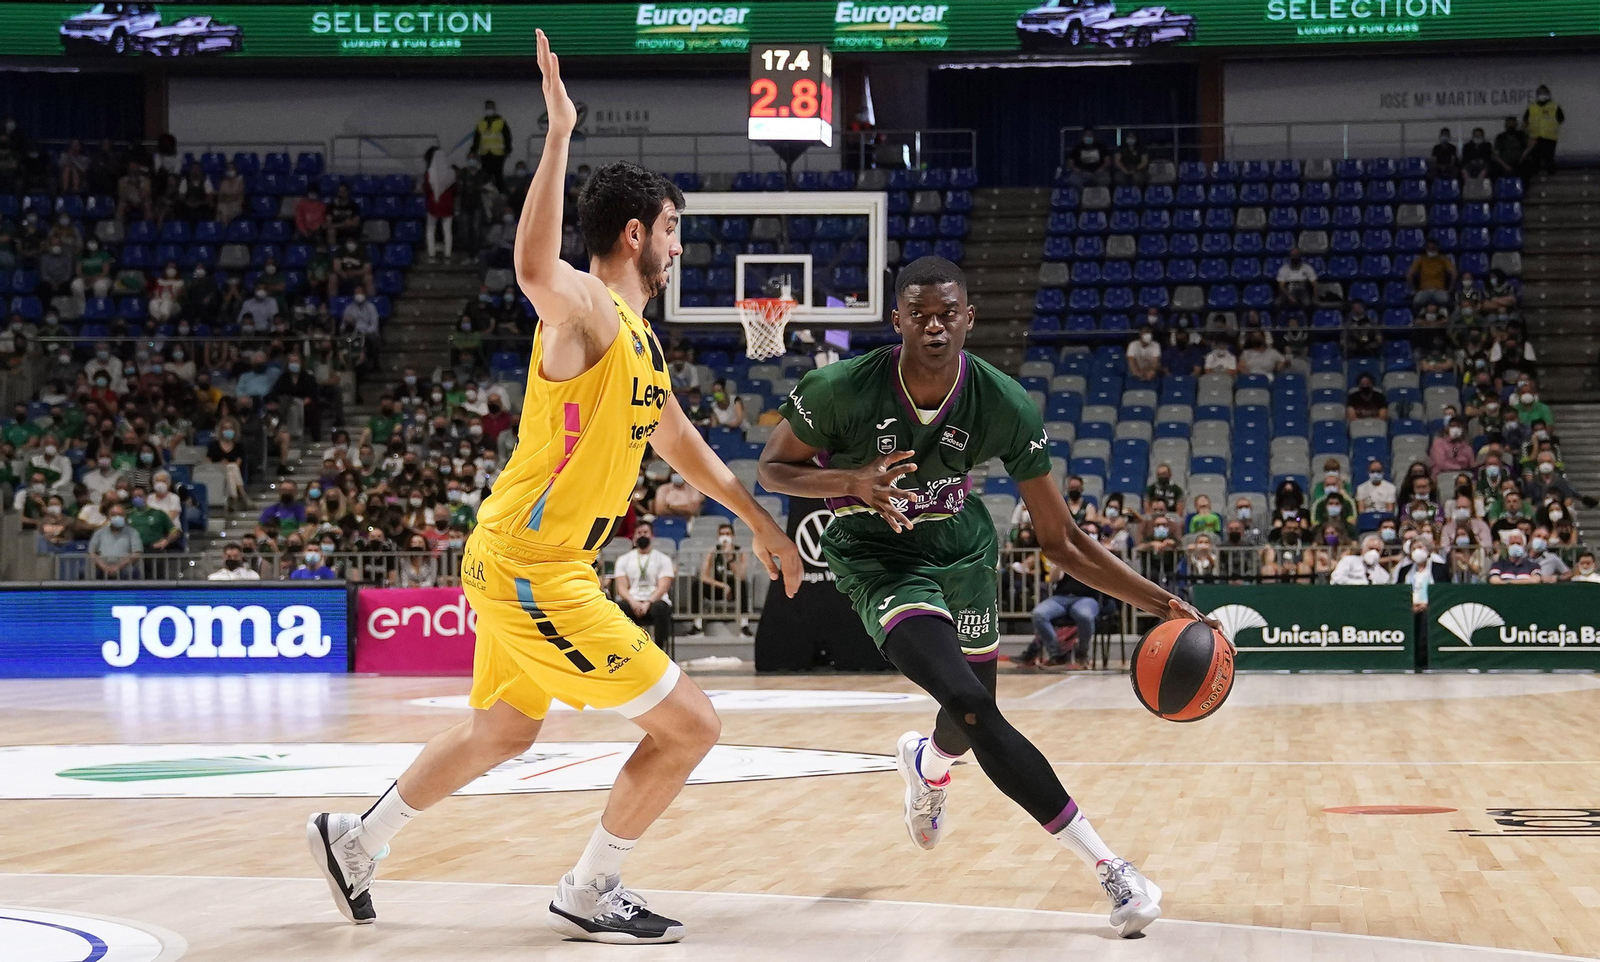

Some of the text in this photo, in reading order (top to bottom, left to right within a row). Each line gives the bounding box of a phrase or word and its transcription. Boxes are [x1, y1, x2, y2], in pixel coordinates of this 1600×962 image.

[636, 4, 750, 32] Europcar
[835, 1, 949, 30] Europcar
[1267, 0, 1450, 20] SELECTION
[312, 11, 492, 33] SELECTION
[1297, 24, 1420, 35] LUXURY & FUN CARS
[341, 40, 461, 48] LUXURY & FUN CARS
[635, 38, 685, 51] moving
[719, 38, 749, 48] way
[833, 36, 884, 48] moving
[918, 36, 948, 47] way
[761, 49, 810, 71] 17.4
[750, 78, 819, 118] 2.8
[102, 604, 332, 667] Joma
[1262, 624, 1405, 647] Unicaja Banco
[1500, 623, 1579, 647] Unicaja
